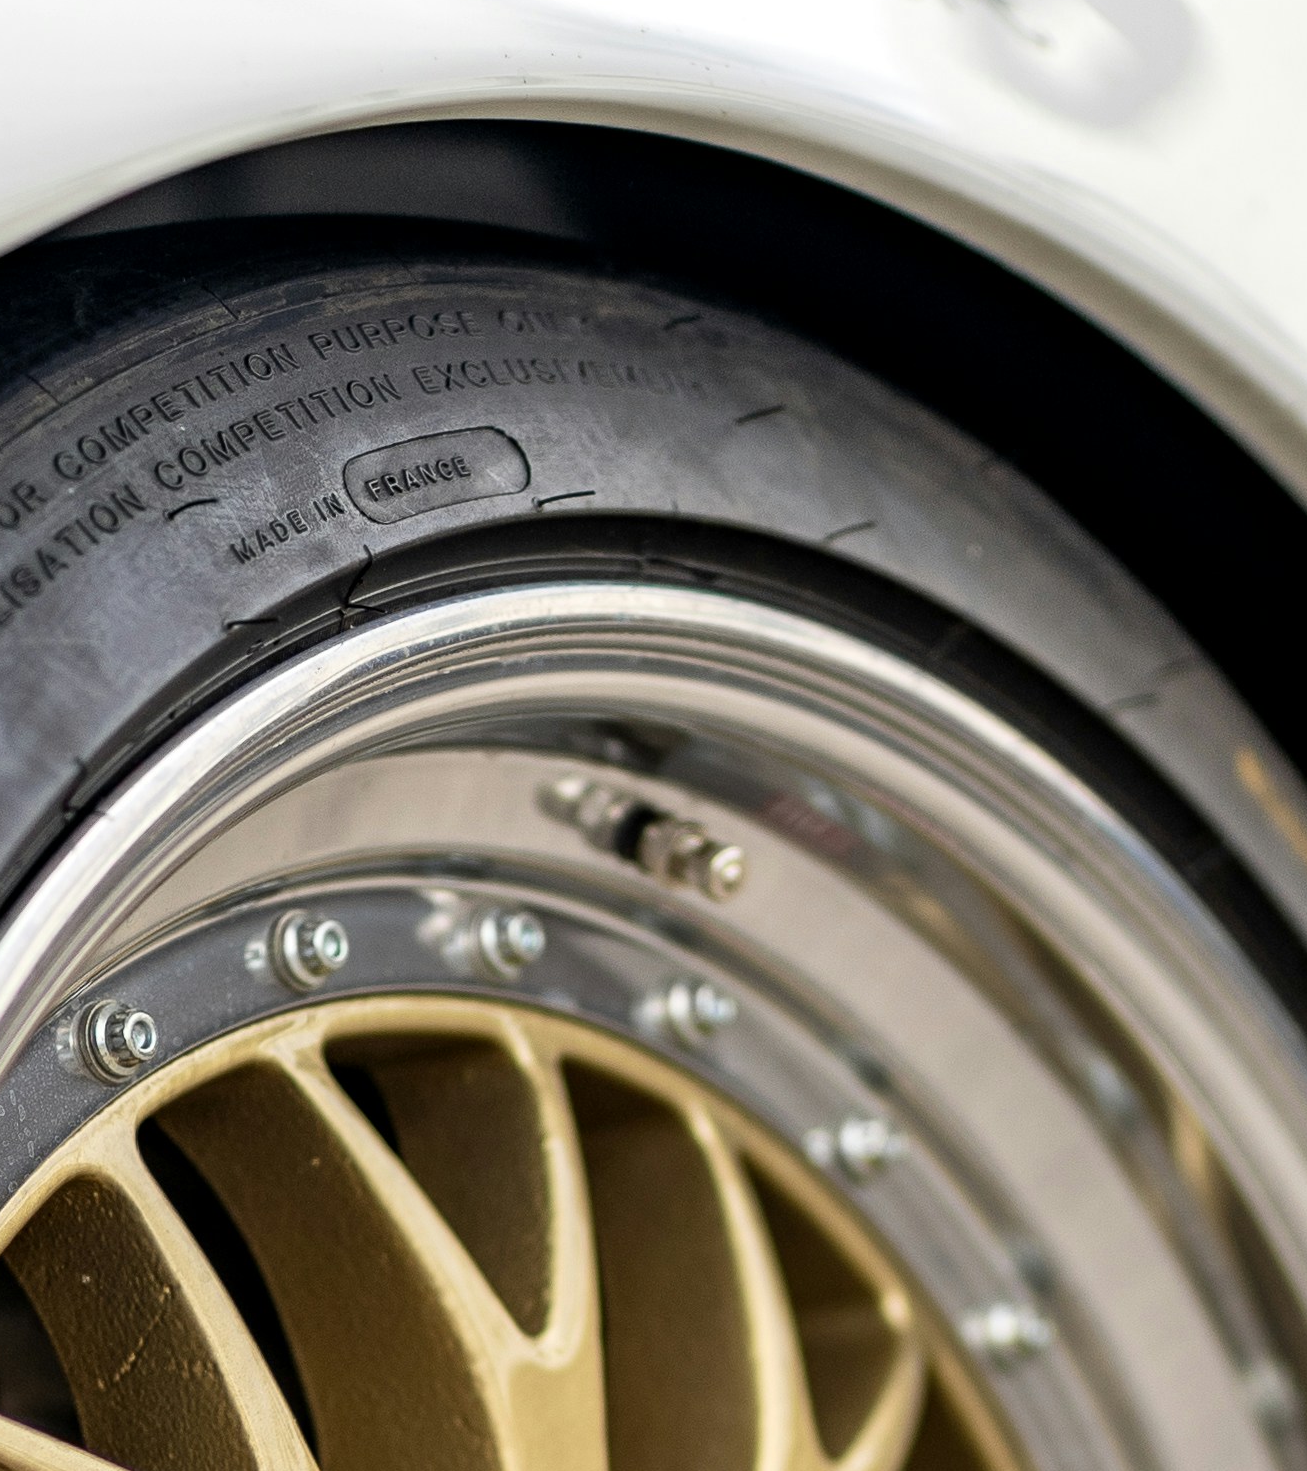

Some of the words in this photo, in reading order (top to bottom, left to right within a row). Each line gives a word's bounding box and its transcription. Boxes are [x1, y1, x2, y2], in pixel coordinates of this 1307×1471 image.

[51, 341, 300, 481] COMPETITION
[310, 310, 481, 361] PURPOSE
[152, 371, 402, 495] COMPETITION
[226, 504, 310, 567] MADE
[316, 493, 350, 526] IN
[364, 454, 475, 505] FRANCE
